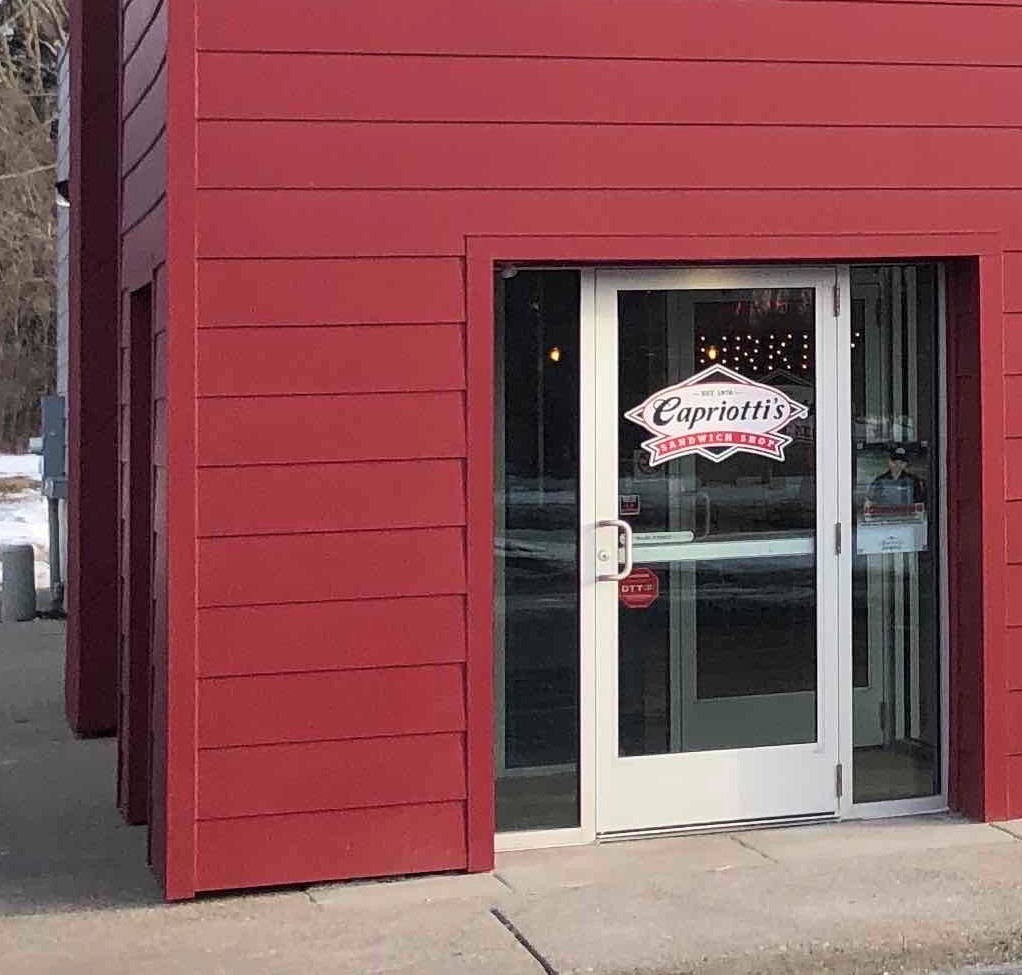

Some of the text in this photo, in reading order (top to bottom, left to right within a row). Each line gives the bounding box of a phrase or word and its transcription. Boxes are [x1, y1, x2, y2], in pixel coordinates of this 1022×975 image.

[652, 396, 786, 430] Capriotti's
[660, 432, 776, 451] SANDWICH SHOP
